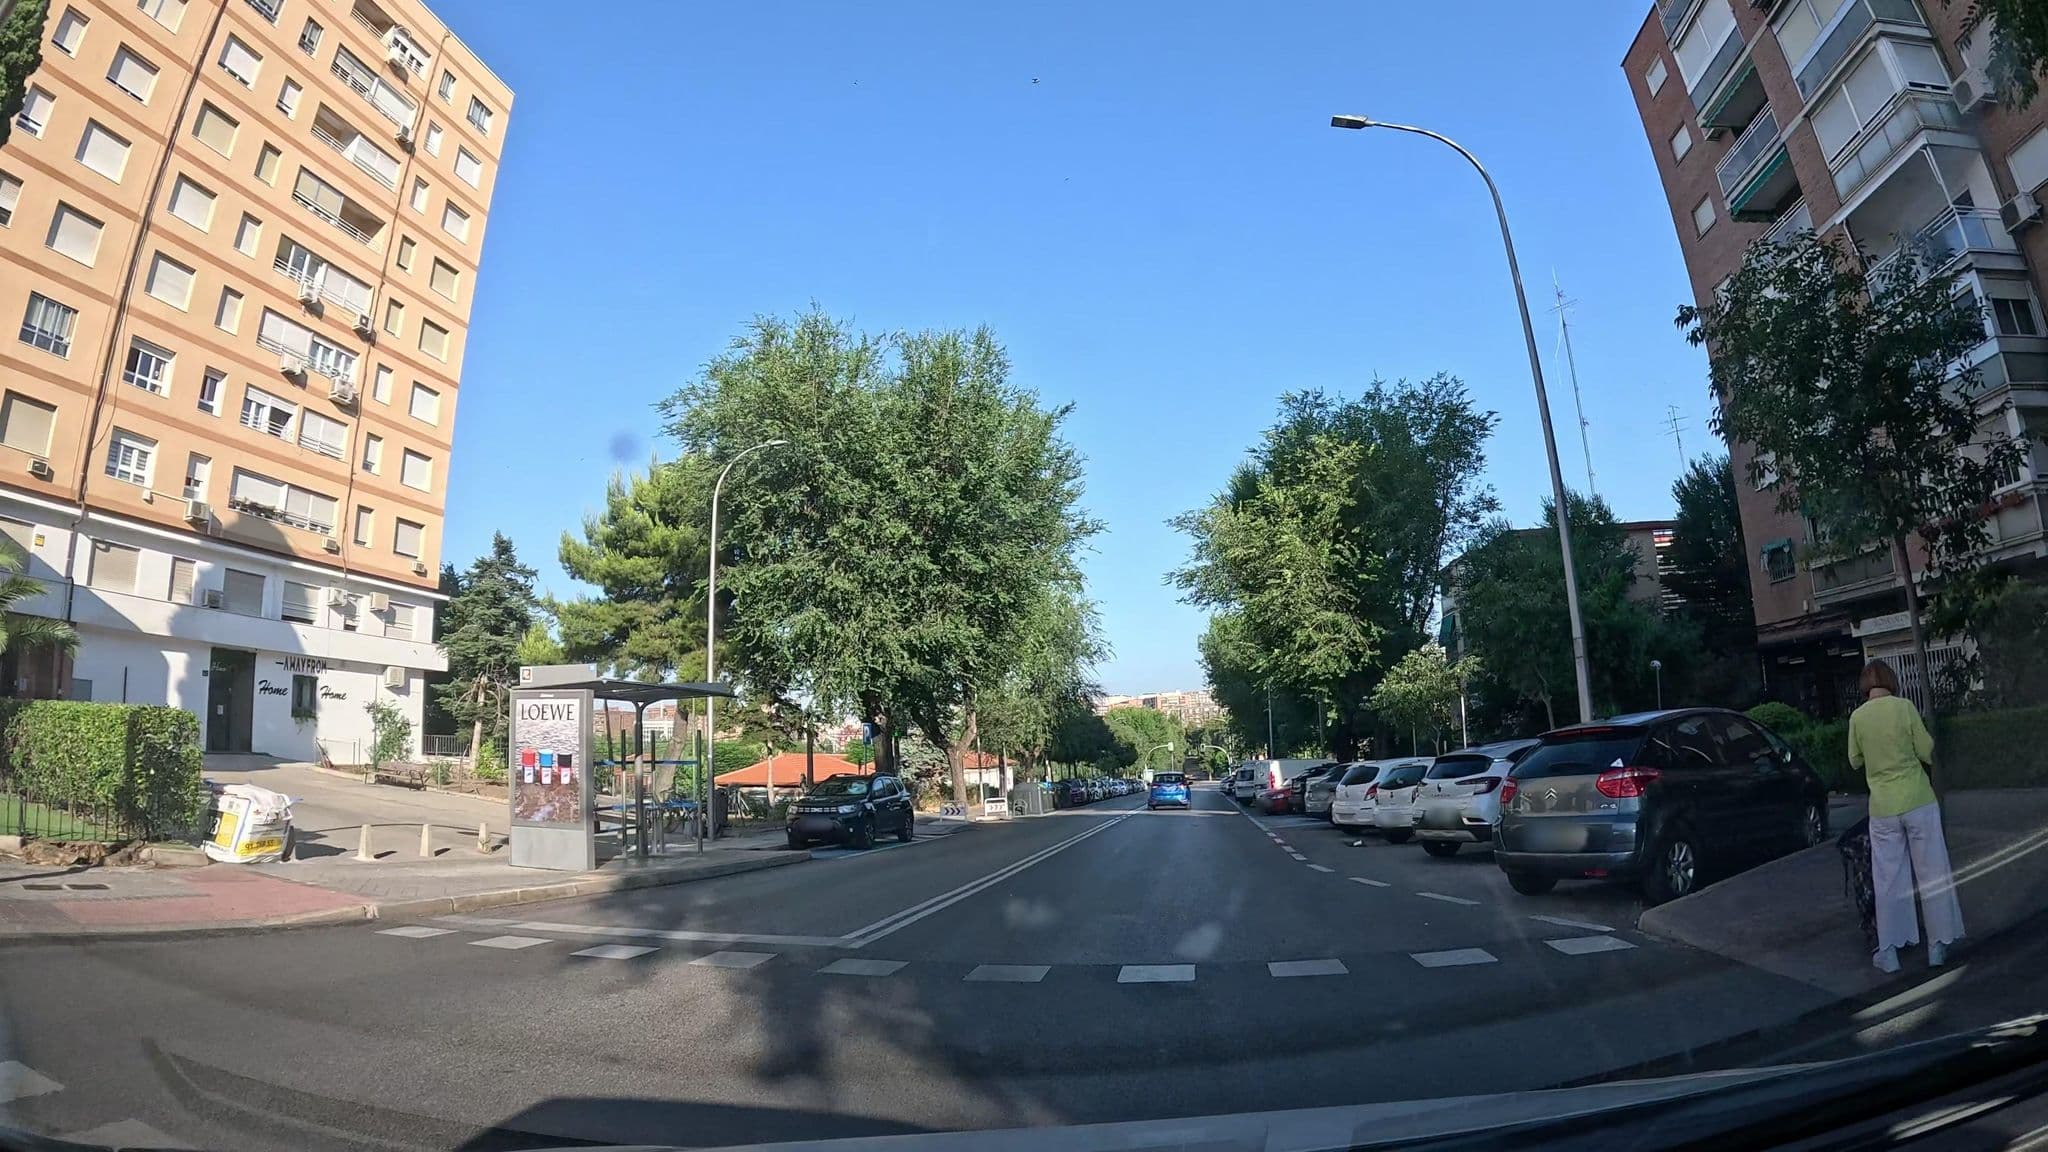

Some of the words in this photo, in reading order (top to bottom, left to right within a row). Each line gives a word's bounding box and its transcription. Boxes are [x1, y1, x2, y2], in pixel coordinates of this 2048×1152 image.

[258, 679, 288, 696] Home
[320, 685, 347, 700] Home
[521, 703, 575, 721] LOEWE
